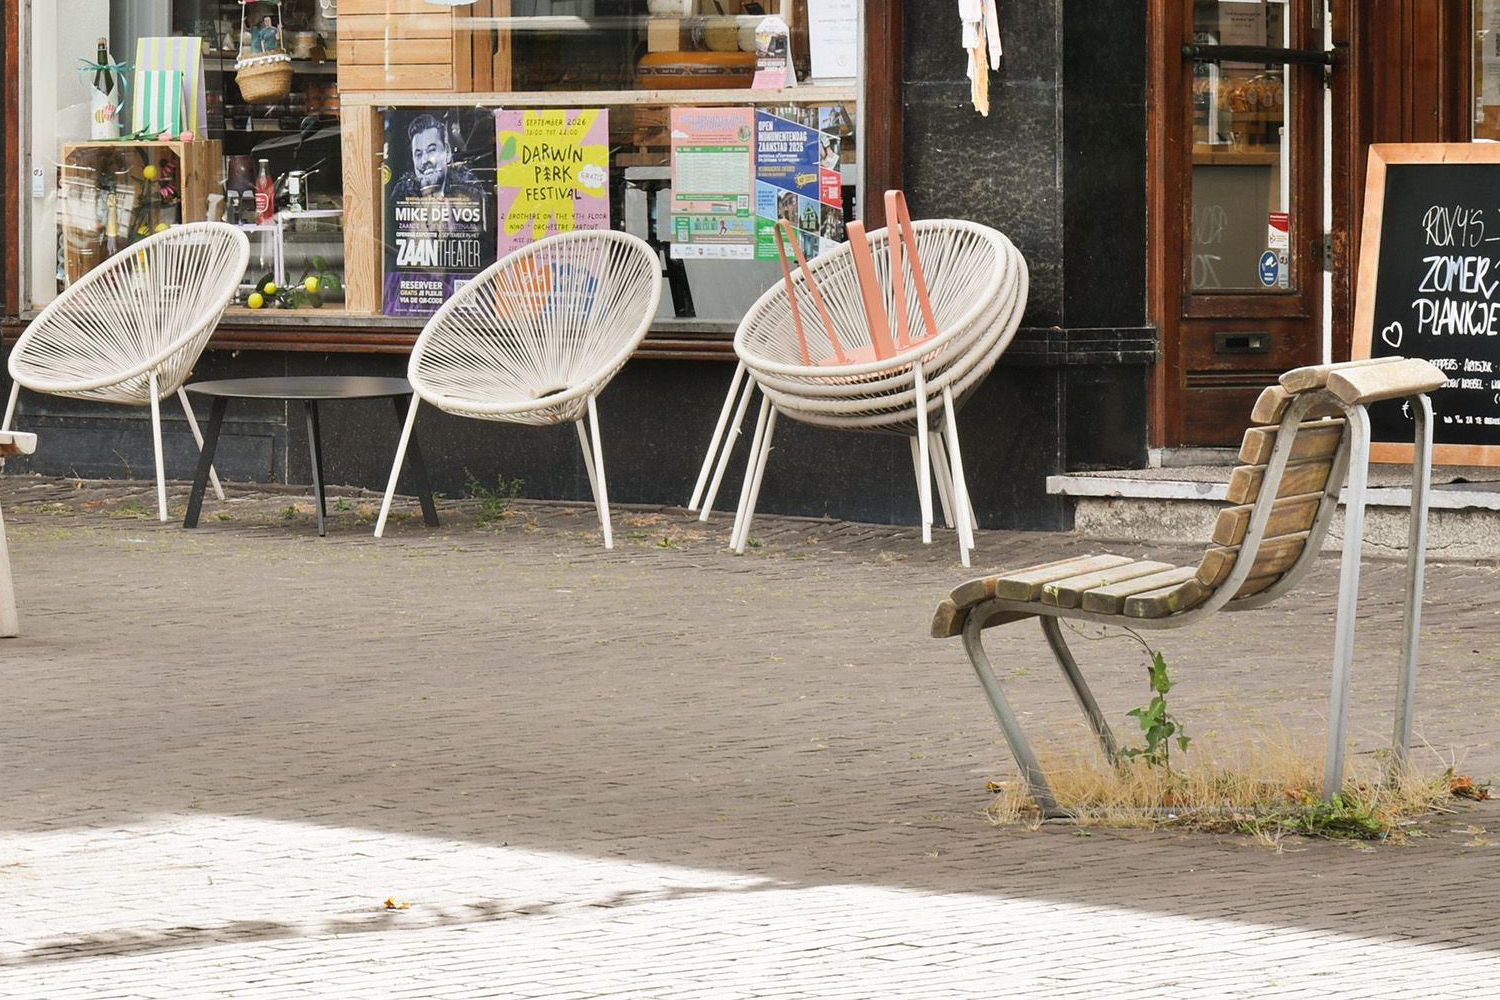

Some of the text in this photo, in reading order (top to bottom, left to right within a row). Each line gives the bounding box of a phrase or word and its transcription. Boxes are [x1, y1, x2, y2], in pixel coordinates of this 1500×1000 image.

[526, 119, 563, 127] SEPTEMBER
[521, 143, 584, 165] DARWIN
[525, 187, 582, 201] FESTIVAL
[395, 207, 481, 222] MIKE DE VOS
[1422, 205, 1485, 247] ROXY'S
[395, 239, 481, 268] ZAANTHEATER
[400, 280, 443, 291] RESERVEER
[1418, 255, 1499, 299] ZOMER
